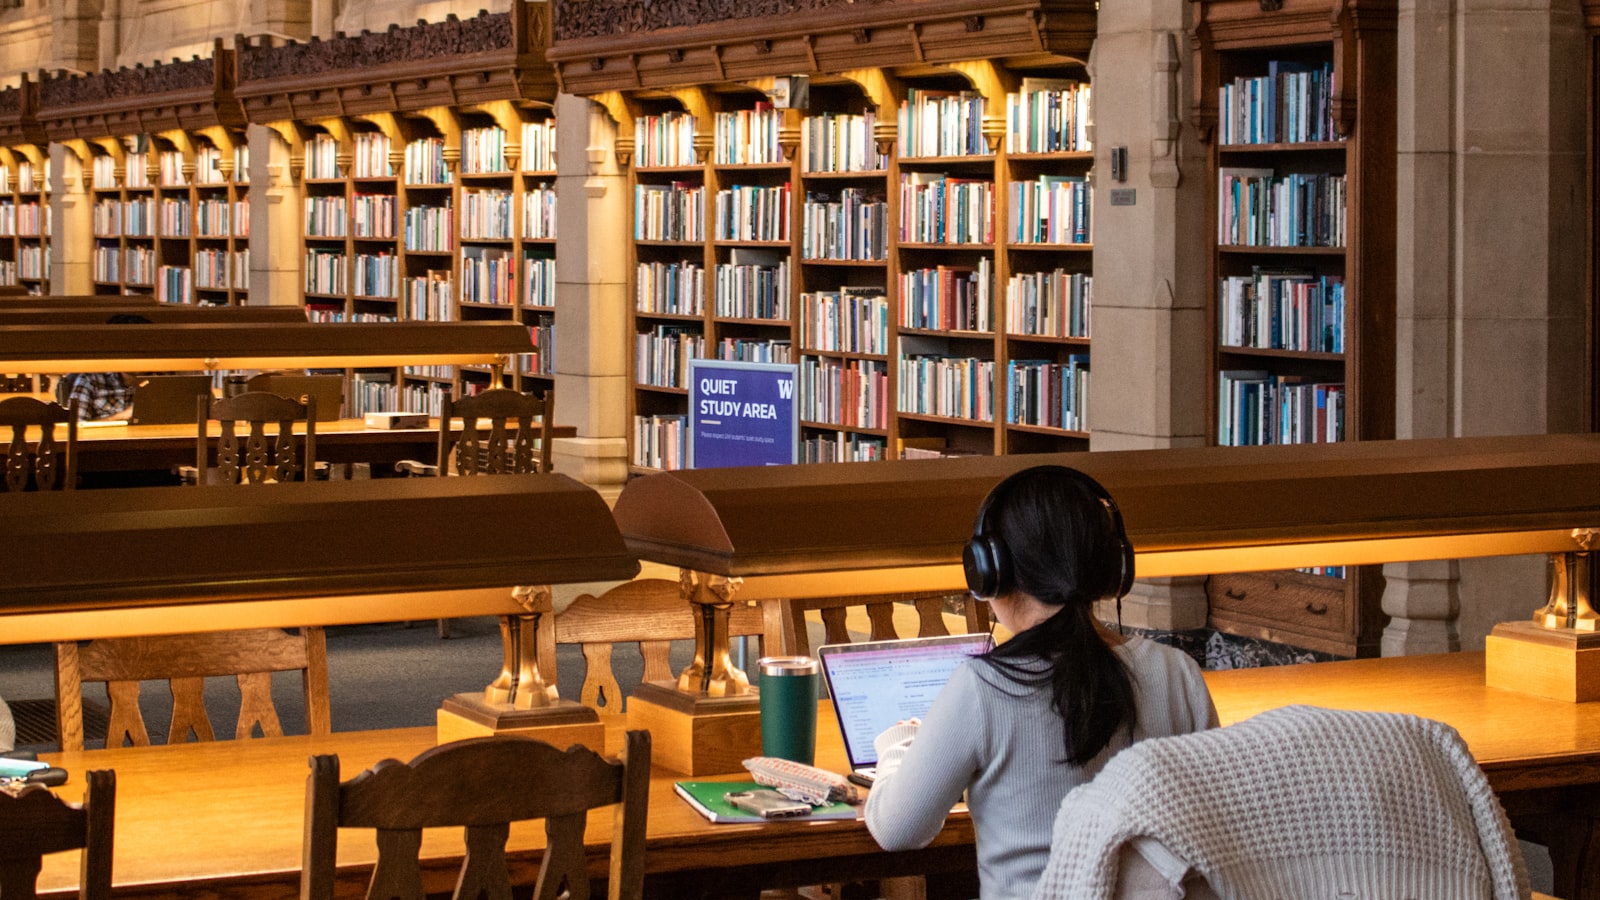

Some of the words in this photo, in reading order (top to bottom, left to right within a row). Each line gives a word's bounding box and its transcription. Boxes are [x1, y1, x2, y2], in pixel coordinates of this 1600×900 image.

[701, 378, 738, 396] QUIET
[777, 379, 793, 400] W
[700, 399, 741, 417] STUDY
[742, 402, 777, 420] AREA
